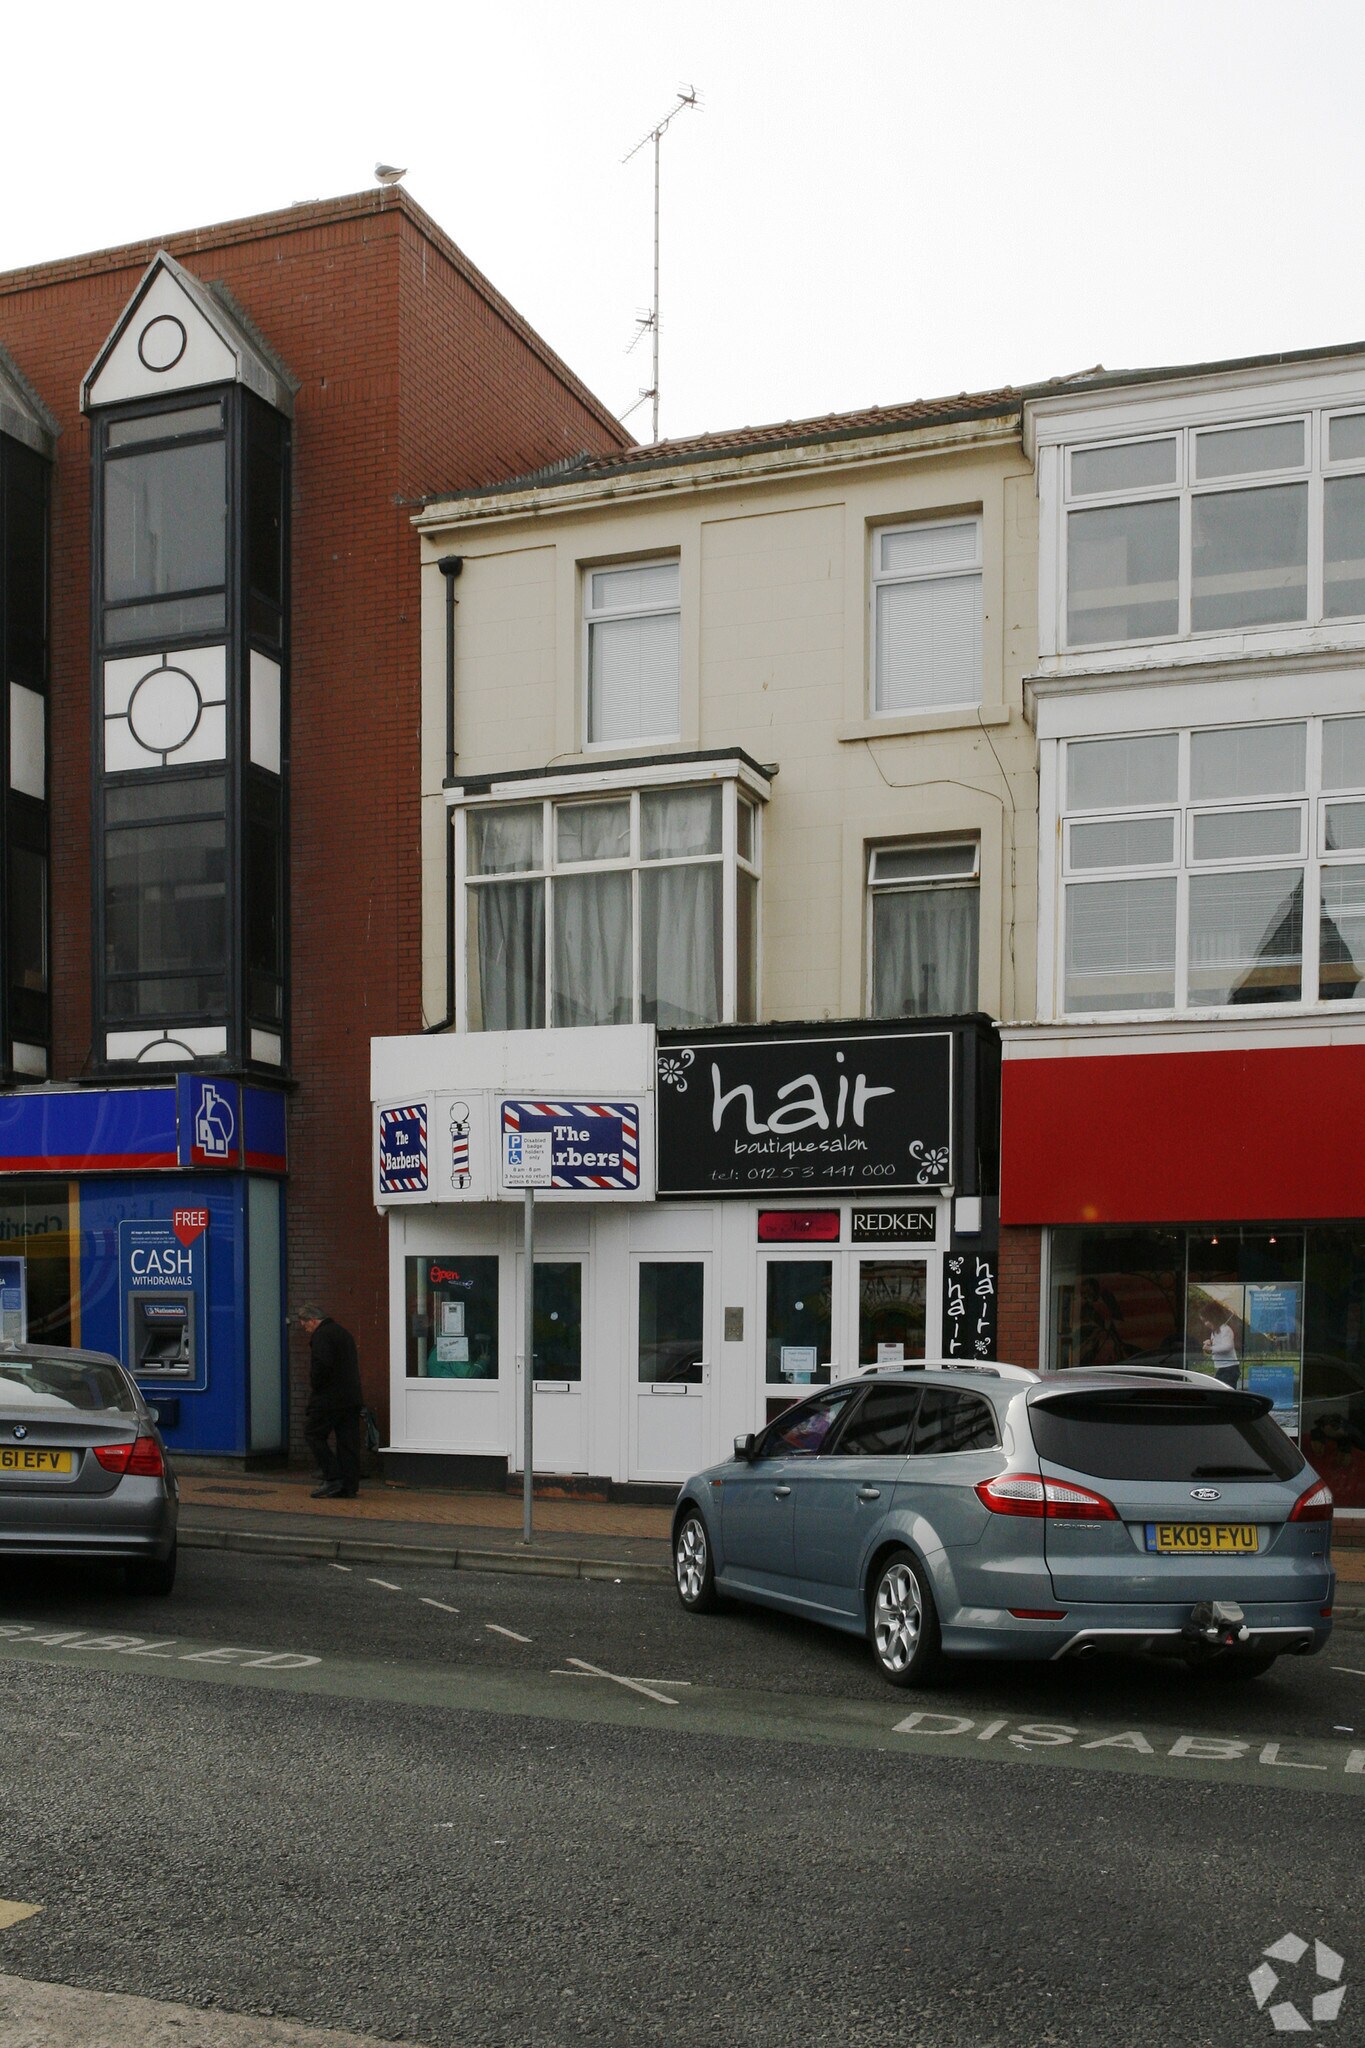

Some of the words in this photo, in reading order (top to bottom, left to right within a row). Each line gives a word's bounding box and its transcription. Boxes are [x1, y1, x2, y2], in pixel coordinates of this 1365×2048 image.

[711, 1051, 895, 1135] hair
[395, 1130, 409, 1145] The
[553, 1126, 590, 1141] The
[386, 1151, 420, 1170] Barbers
[552, 1147, 620, 1167] rbers
[709, 1169, 739, 1181] tel:
[822, 1165, 855, 1177] 441
[862, 1164, 896, 1177] 000
[175, 1211, 206, 1226] FREE
[854, 1213, 934, 1230] REDKEN
[131, 1249, 192, 1274] CASH
[132, 1276, 192, 1285] WITHDRAWALS
[430, 1266, 460, 1282] Open
[975, 1256, 994, 1334] hair
[947, 1278, 965, 1354] hair
[24, 1452, 60, 1468] EFV
[1160, 1527, 1211, 1546] EK09
[1216, 1527, 1253, 1546] FYU
